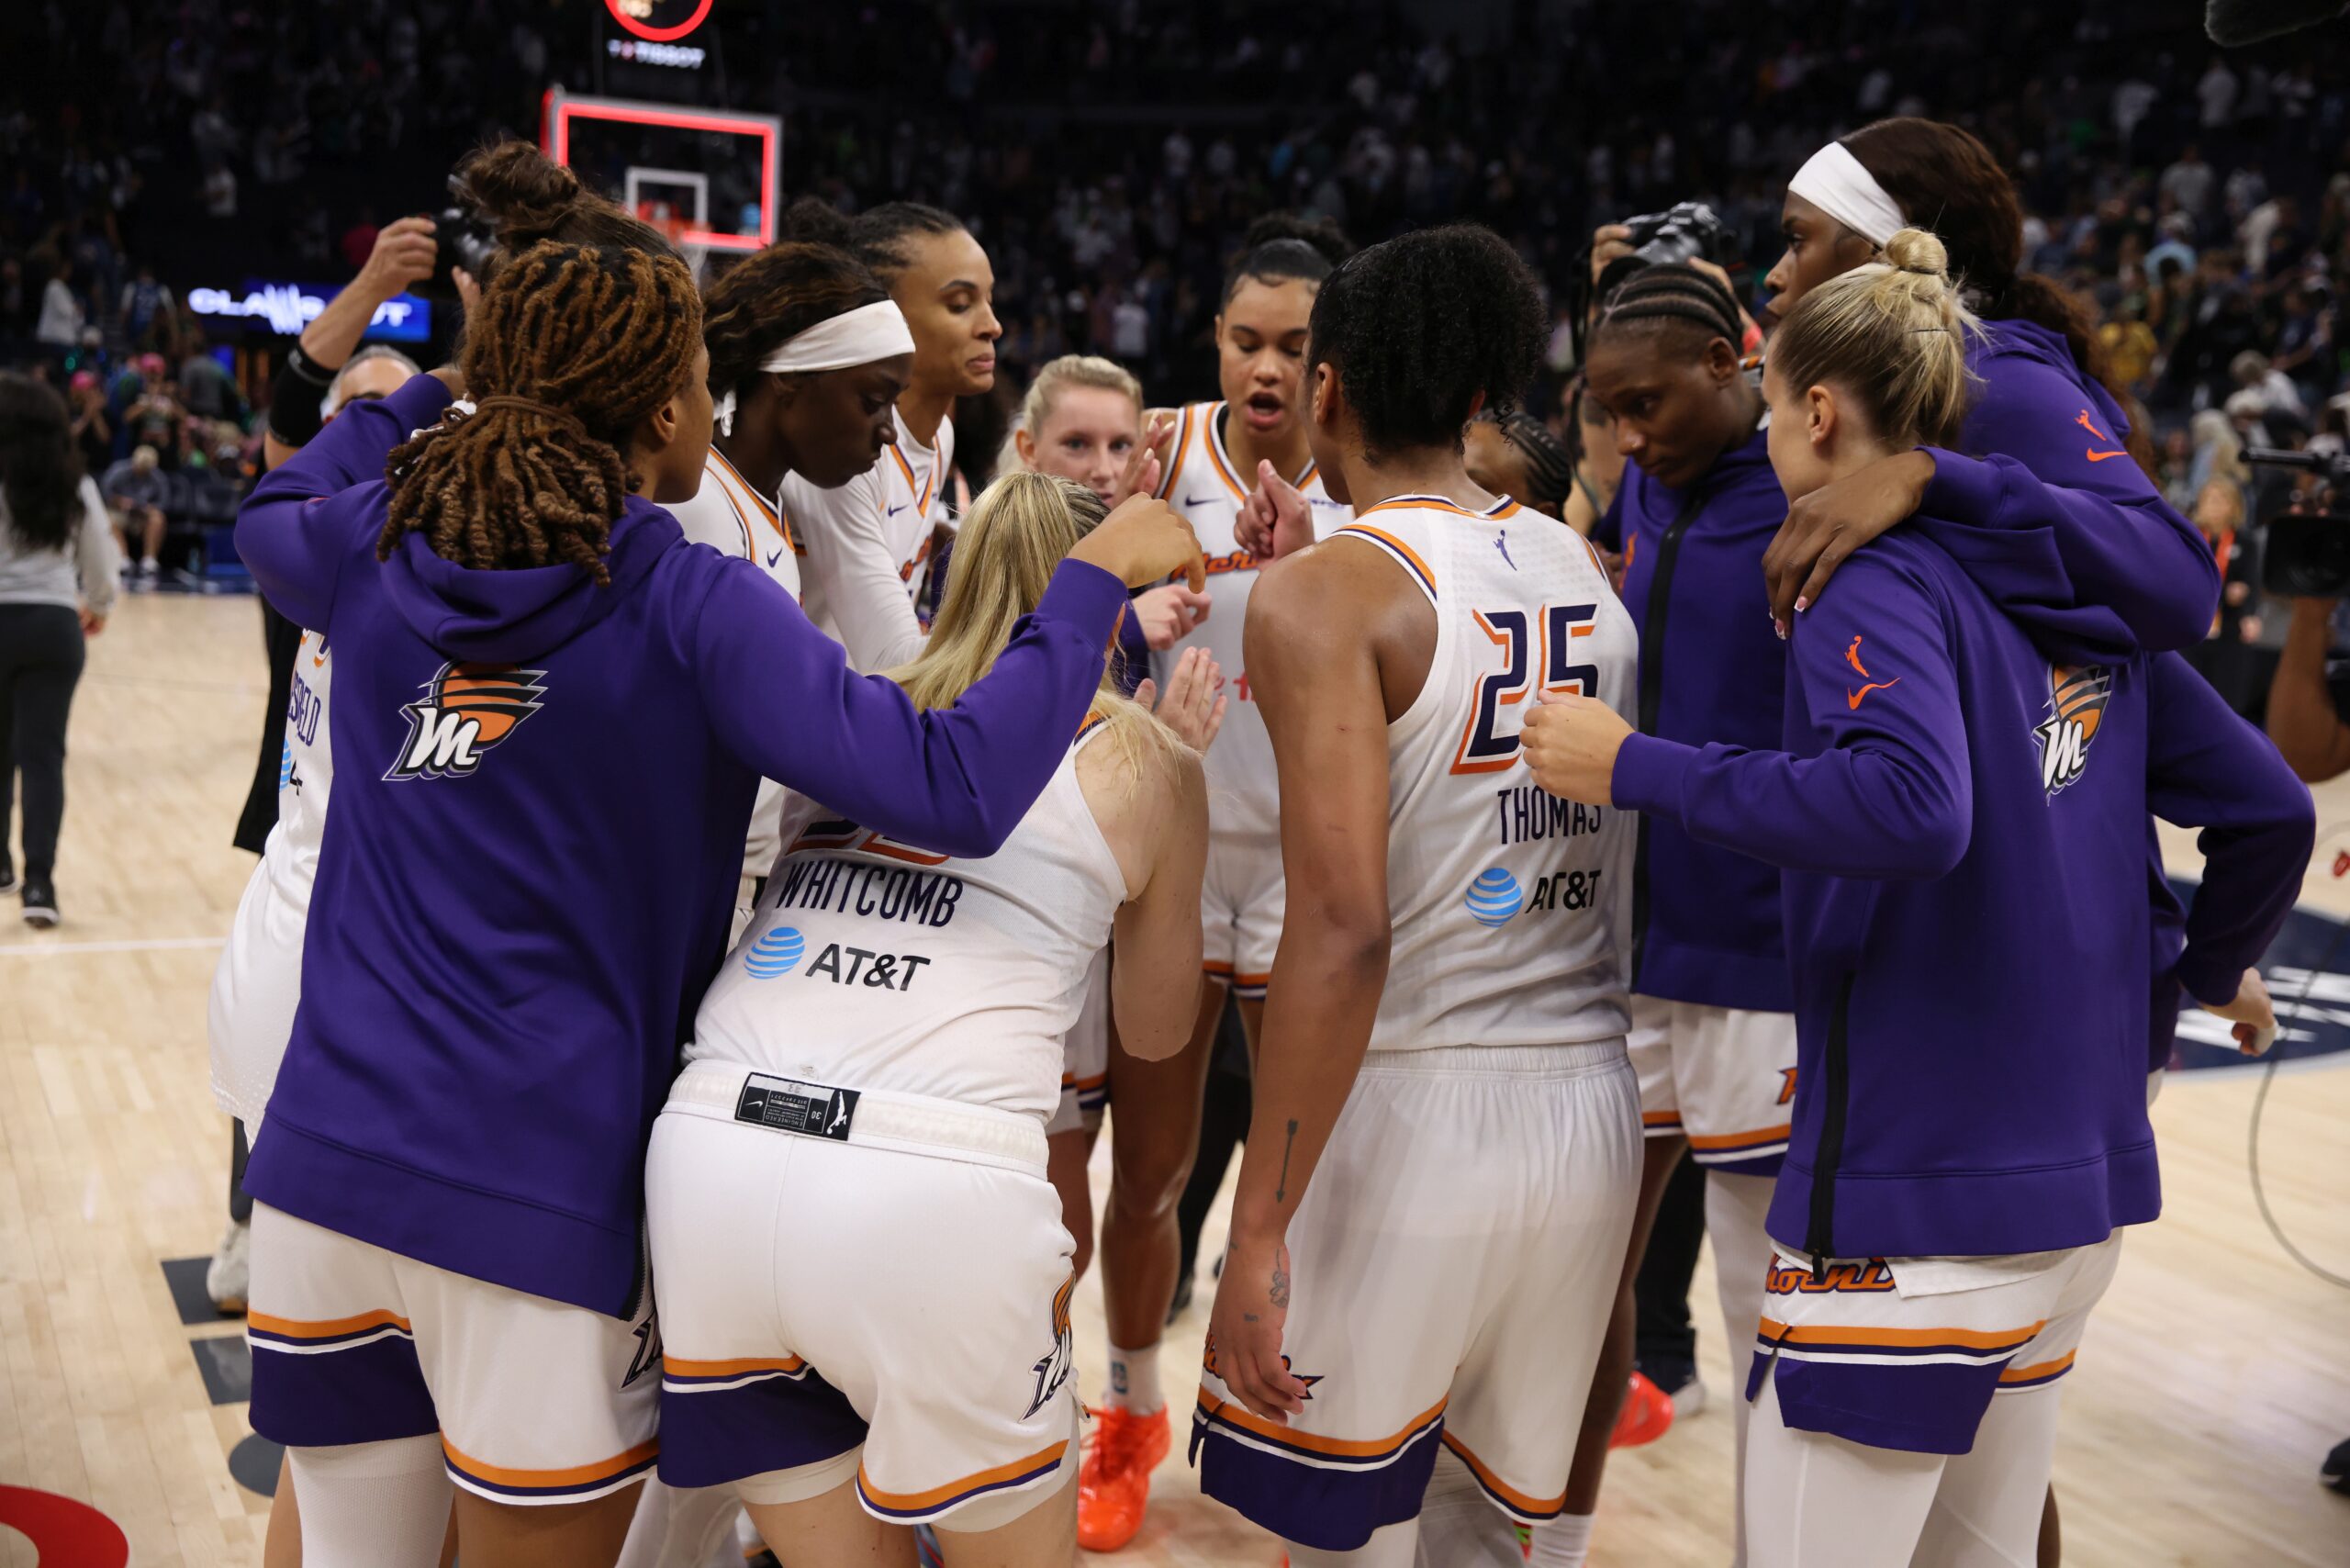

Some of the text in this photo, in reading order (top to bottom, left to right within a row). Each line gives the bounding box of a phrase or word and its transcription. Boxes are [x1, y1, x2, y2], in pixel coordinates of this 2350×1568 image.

[1449, 603, 1600, 775] 25
[1497, 785, 1601, 845] THOMAS
[776, 859, 964, 927] WHITCOMB
[1526, 869, 1601, 913] AT&T
[805, 943, 931, 991] AT&T
